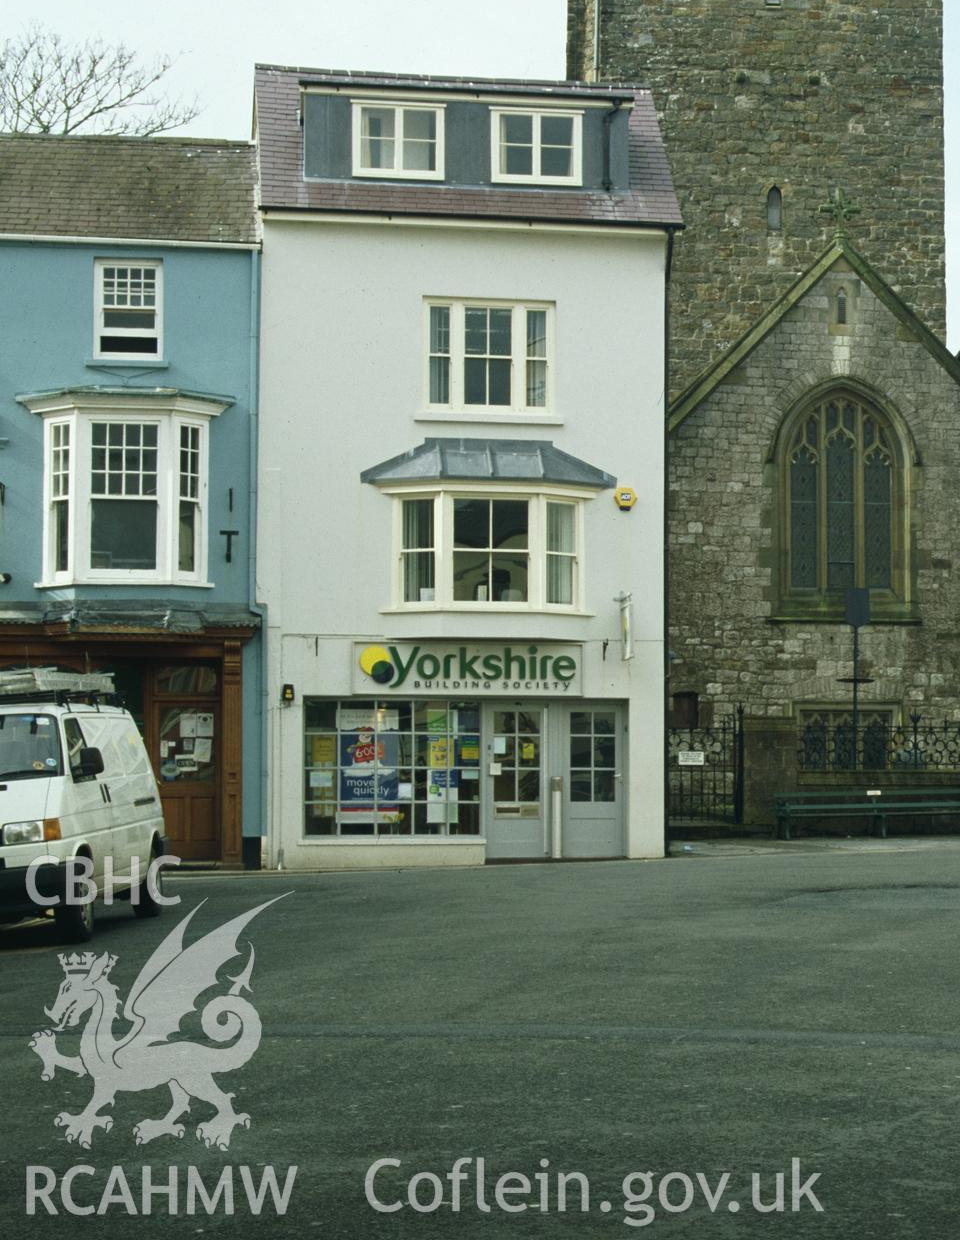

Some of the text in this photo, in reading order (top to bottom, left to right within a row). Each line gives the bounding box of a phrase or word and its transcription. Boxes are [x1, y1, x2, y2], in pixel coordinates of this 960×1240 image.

[388, 645, 577, 688] Yorkshire
[414, 680, 571, 691] BUILDING SOCIETY
